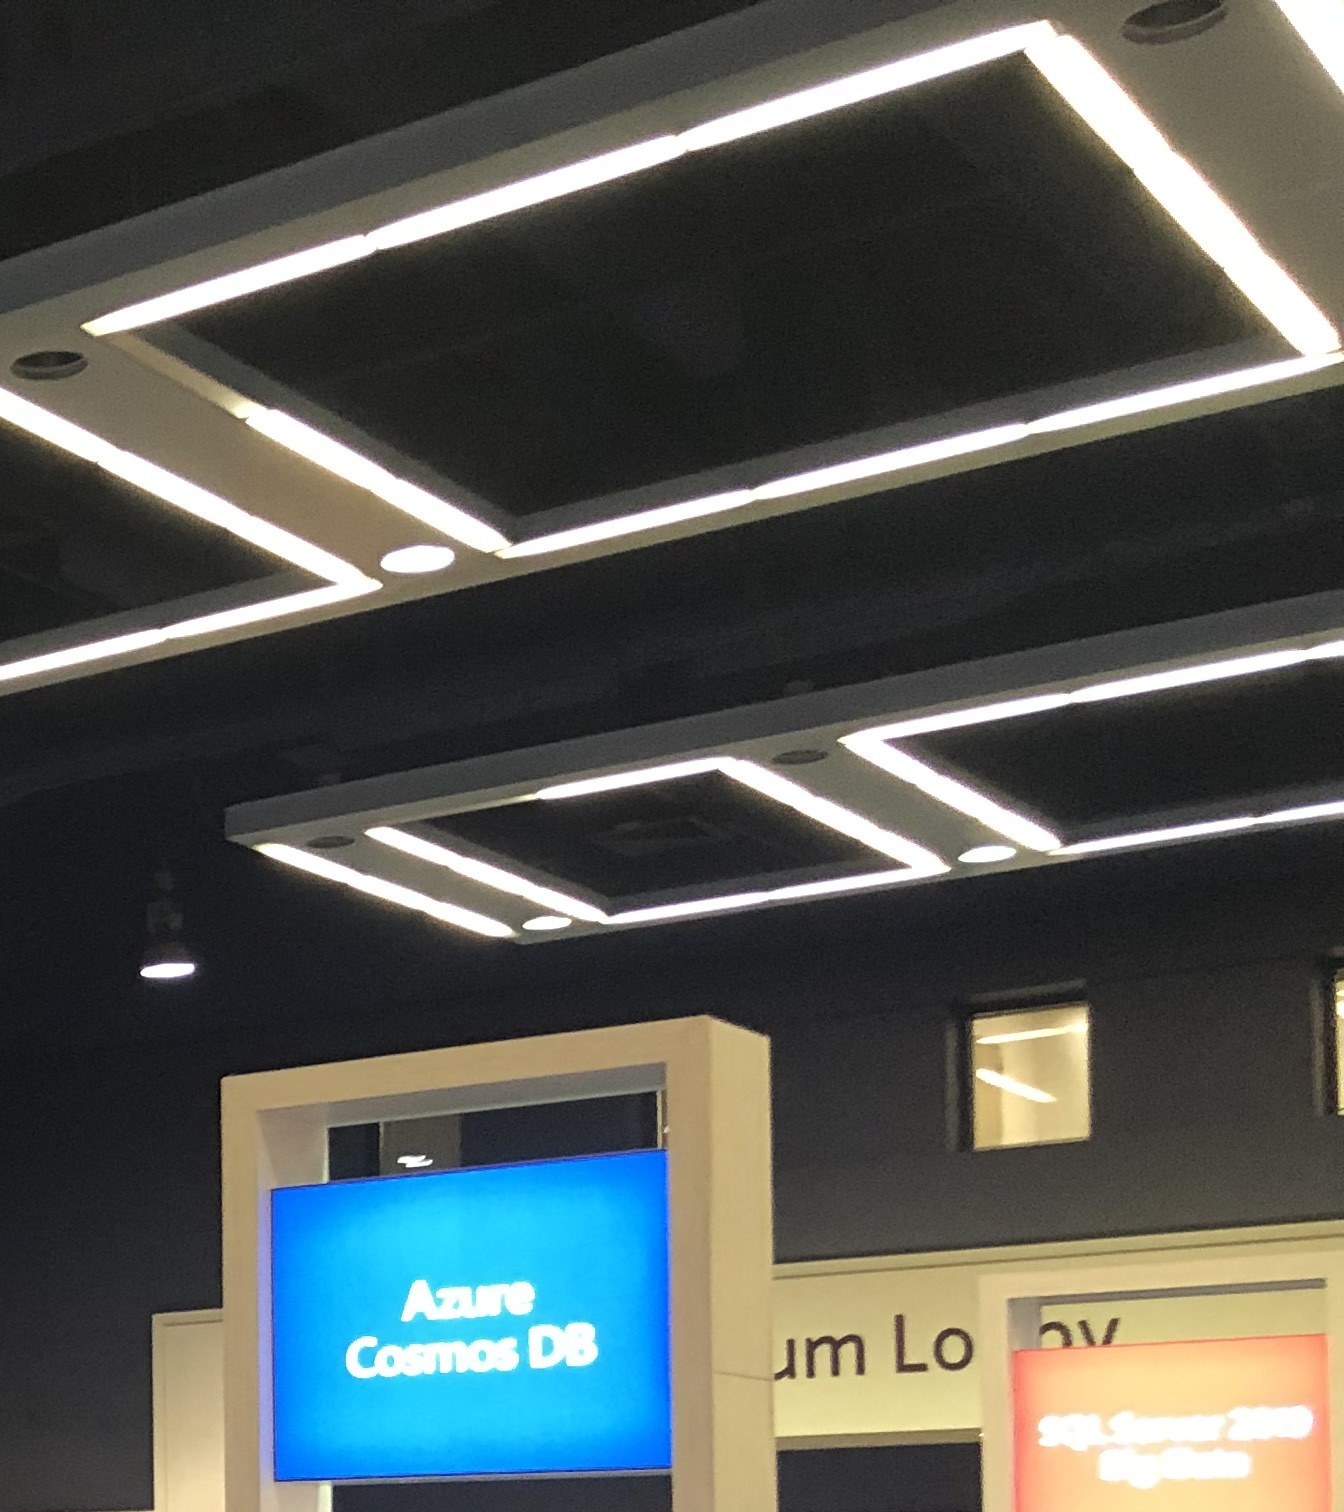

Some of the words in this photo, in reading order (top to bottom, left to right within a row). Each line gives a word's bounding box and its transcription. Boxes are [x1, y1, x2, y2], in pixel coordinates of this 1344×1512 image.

[400, 1279, 536, 1322] Azure
[345, 1336, 521, 1379] Cosmos
[528, 1322, 599, 1369] DB
